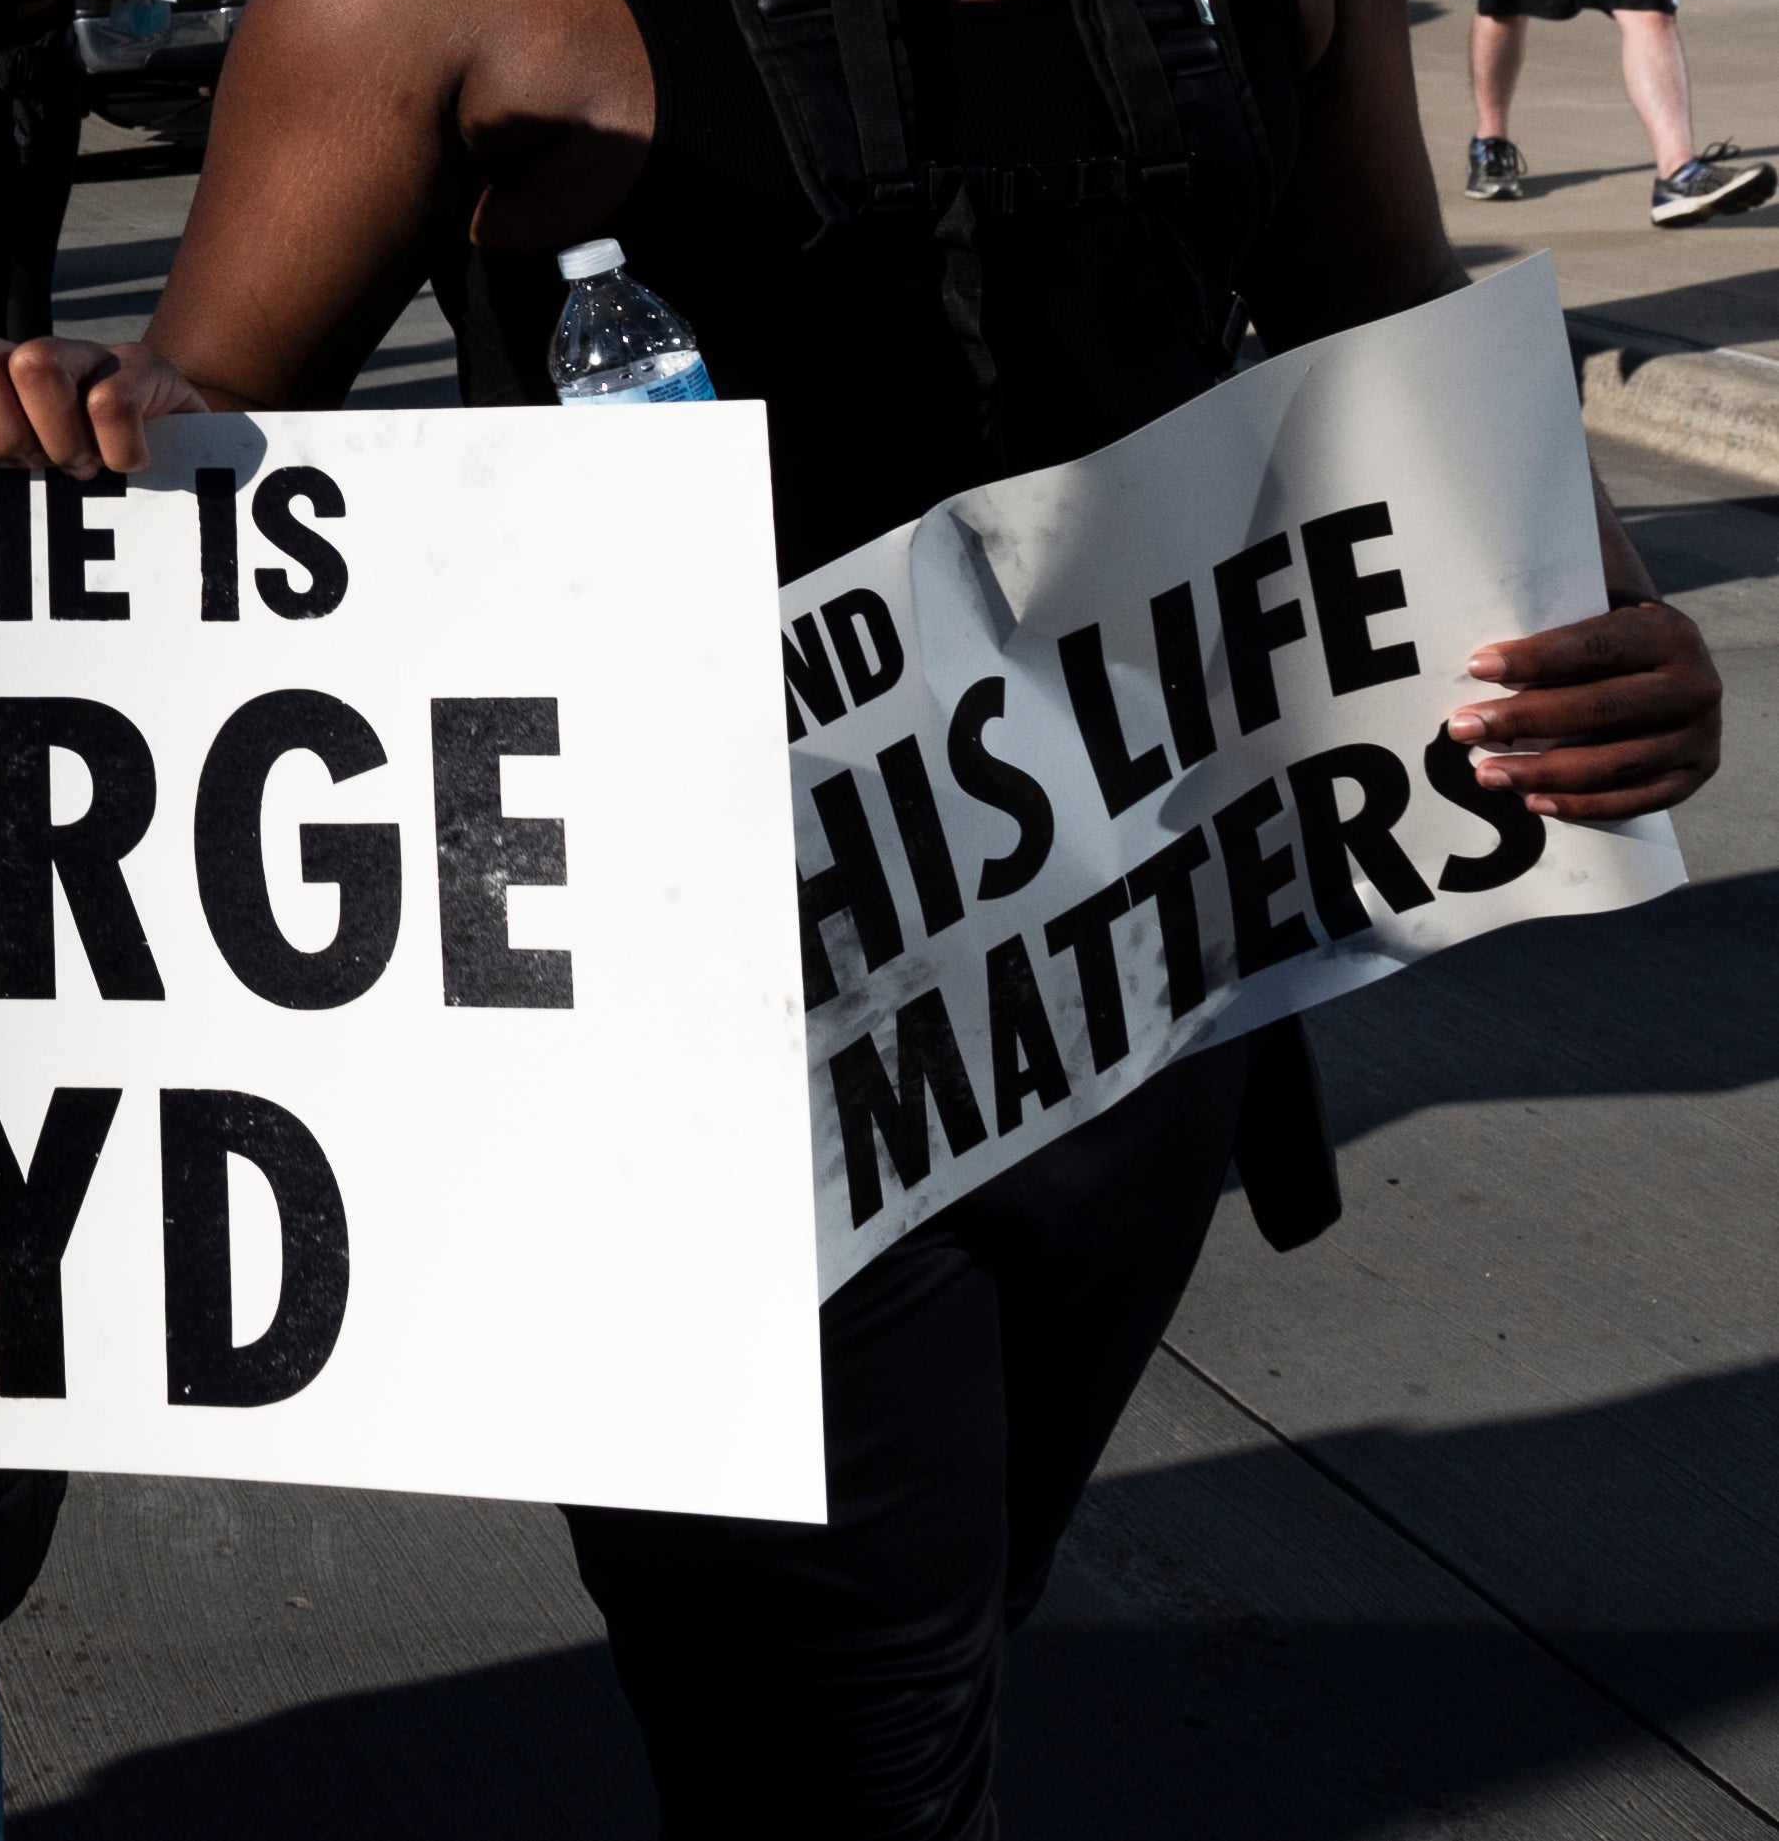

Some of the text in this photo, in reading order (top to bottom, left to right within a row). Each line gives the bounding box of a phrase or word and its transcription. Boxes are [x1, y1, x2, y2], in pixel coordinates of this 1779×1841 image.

[197, 465, 349, 620] IS
[782, 586, 905, 744] ND
[795, 500, 1420, 1013] HIS LIFE
[828, 716, 1547, 1230] MATTERS
